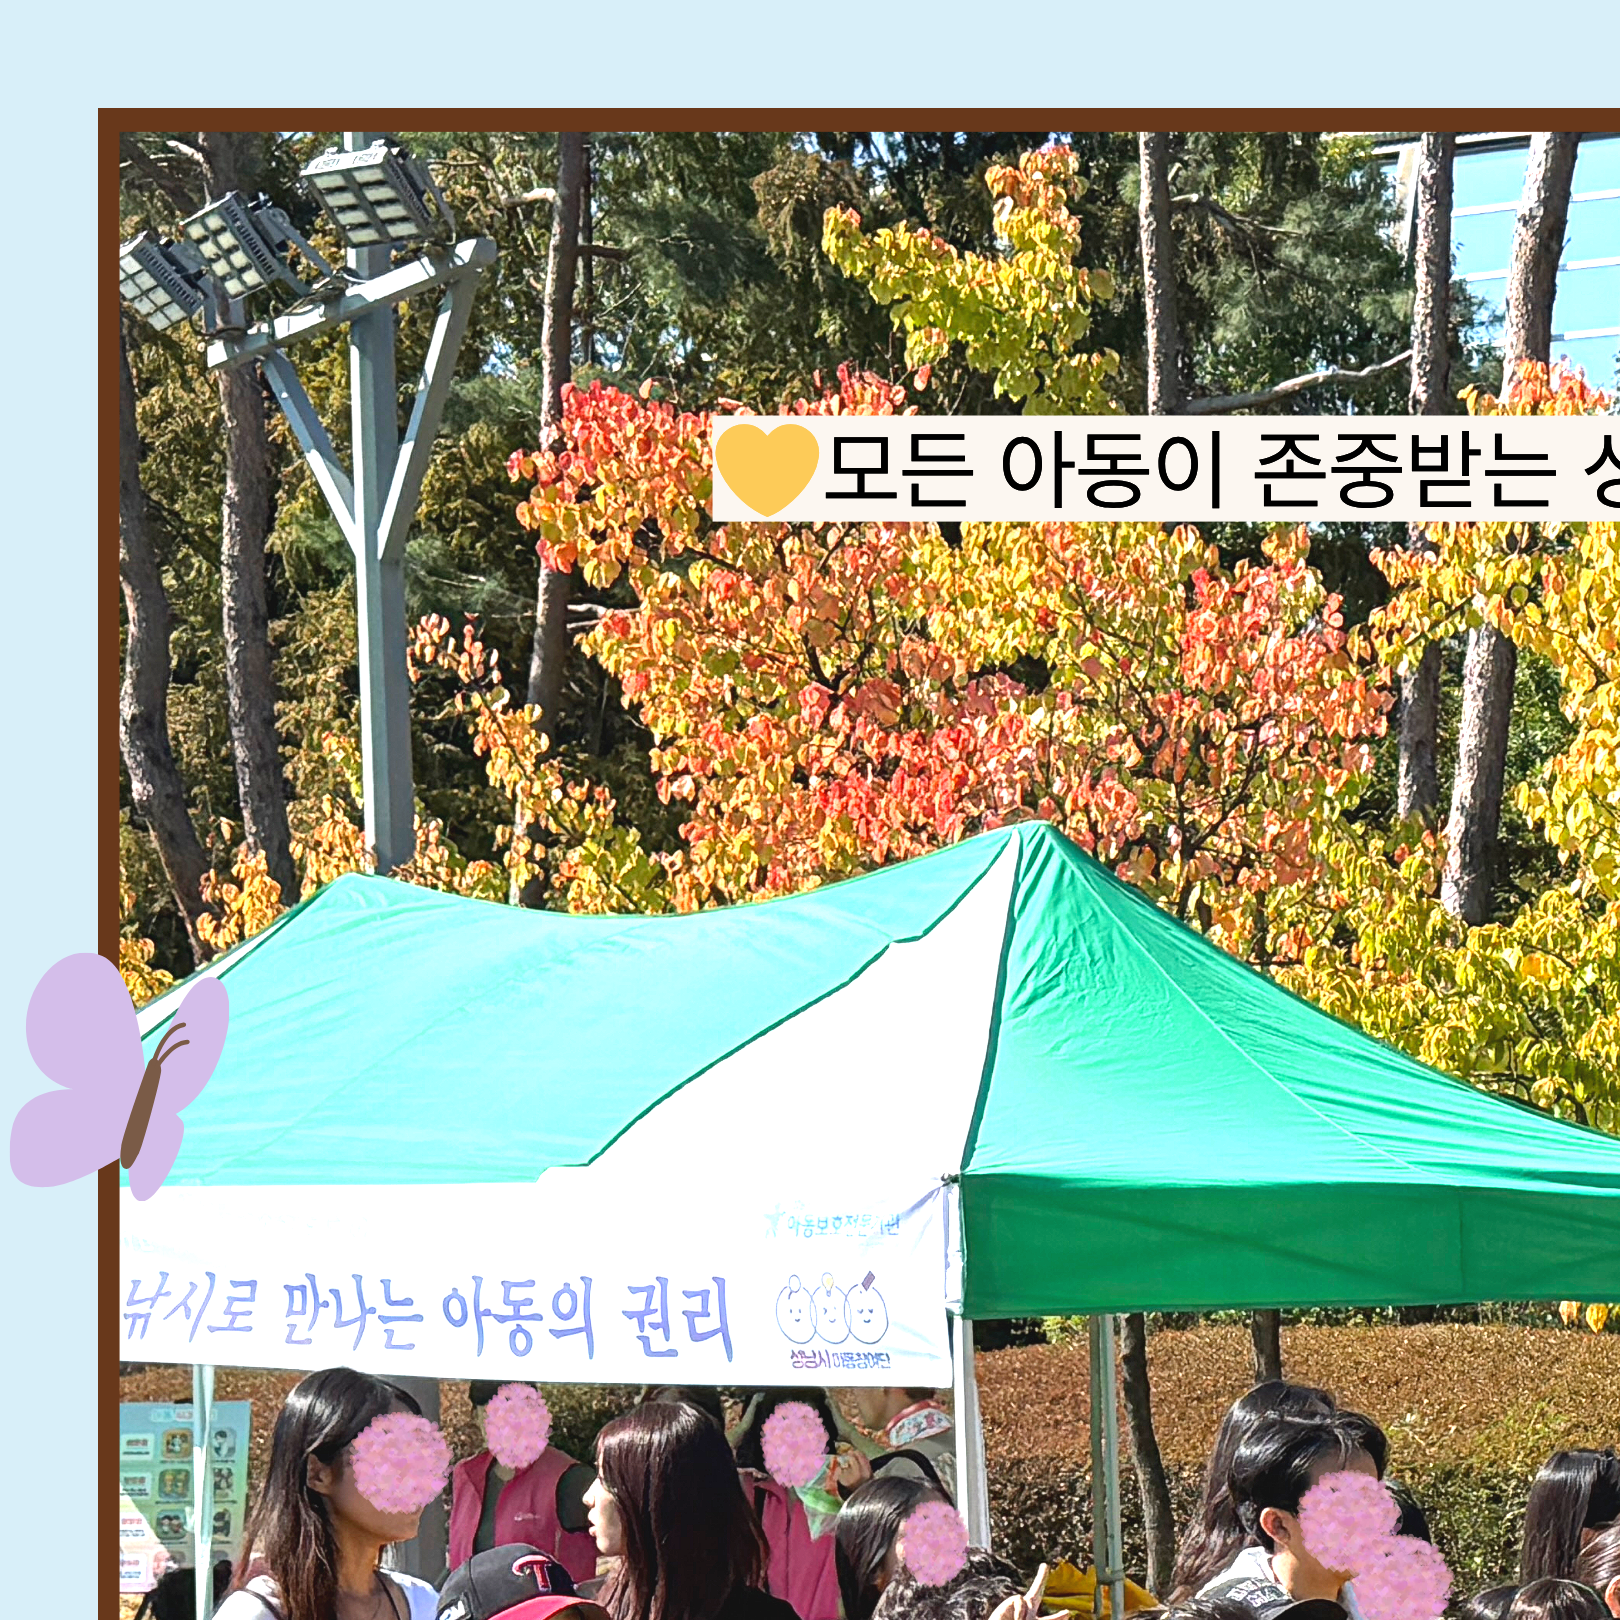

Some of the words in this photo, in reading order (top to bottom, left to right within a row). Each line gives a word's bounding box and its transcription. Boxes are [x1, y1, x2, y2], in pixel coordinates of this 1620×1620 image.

[283, 1272, 424, 1352] 만나는
[442, 1274, 595, 1361] 아동의
[621, 1275, 734, 1364] 권리
[511, 1553, 553, 1592] T
